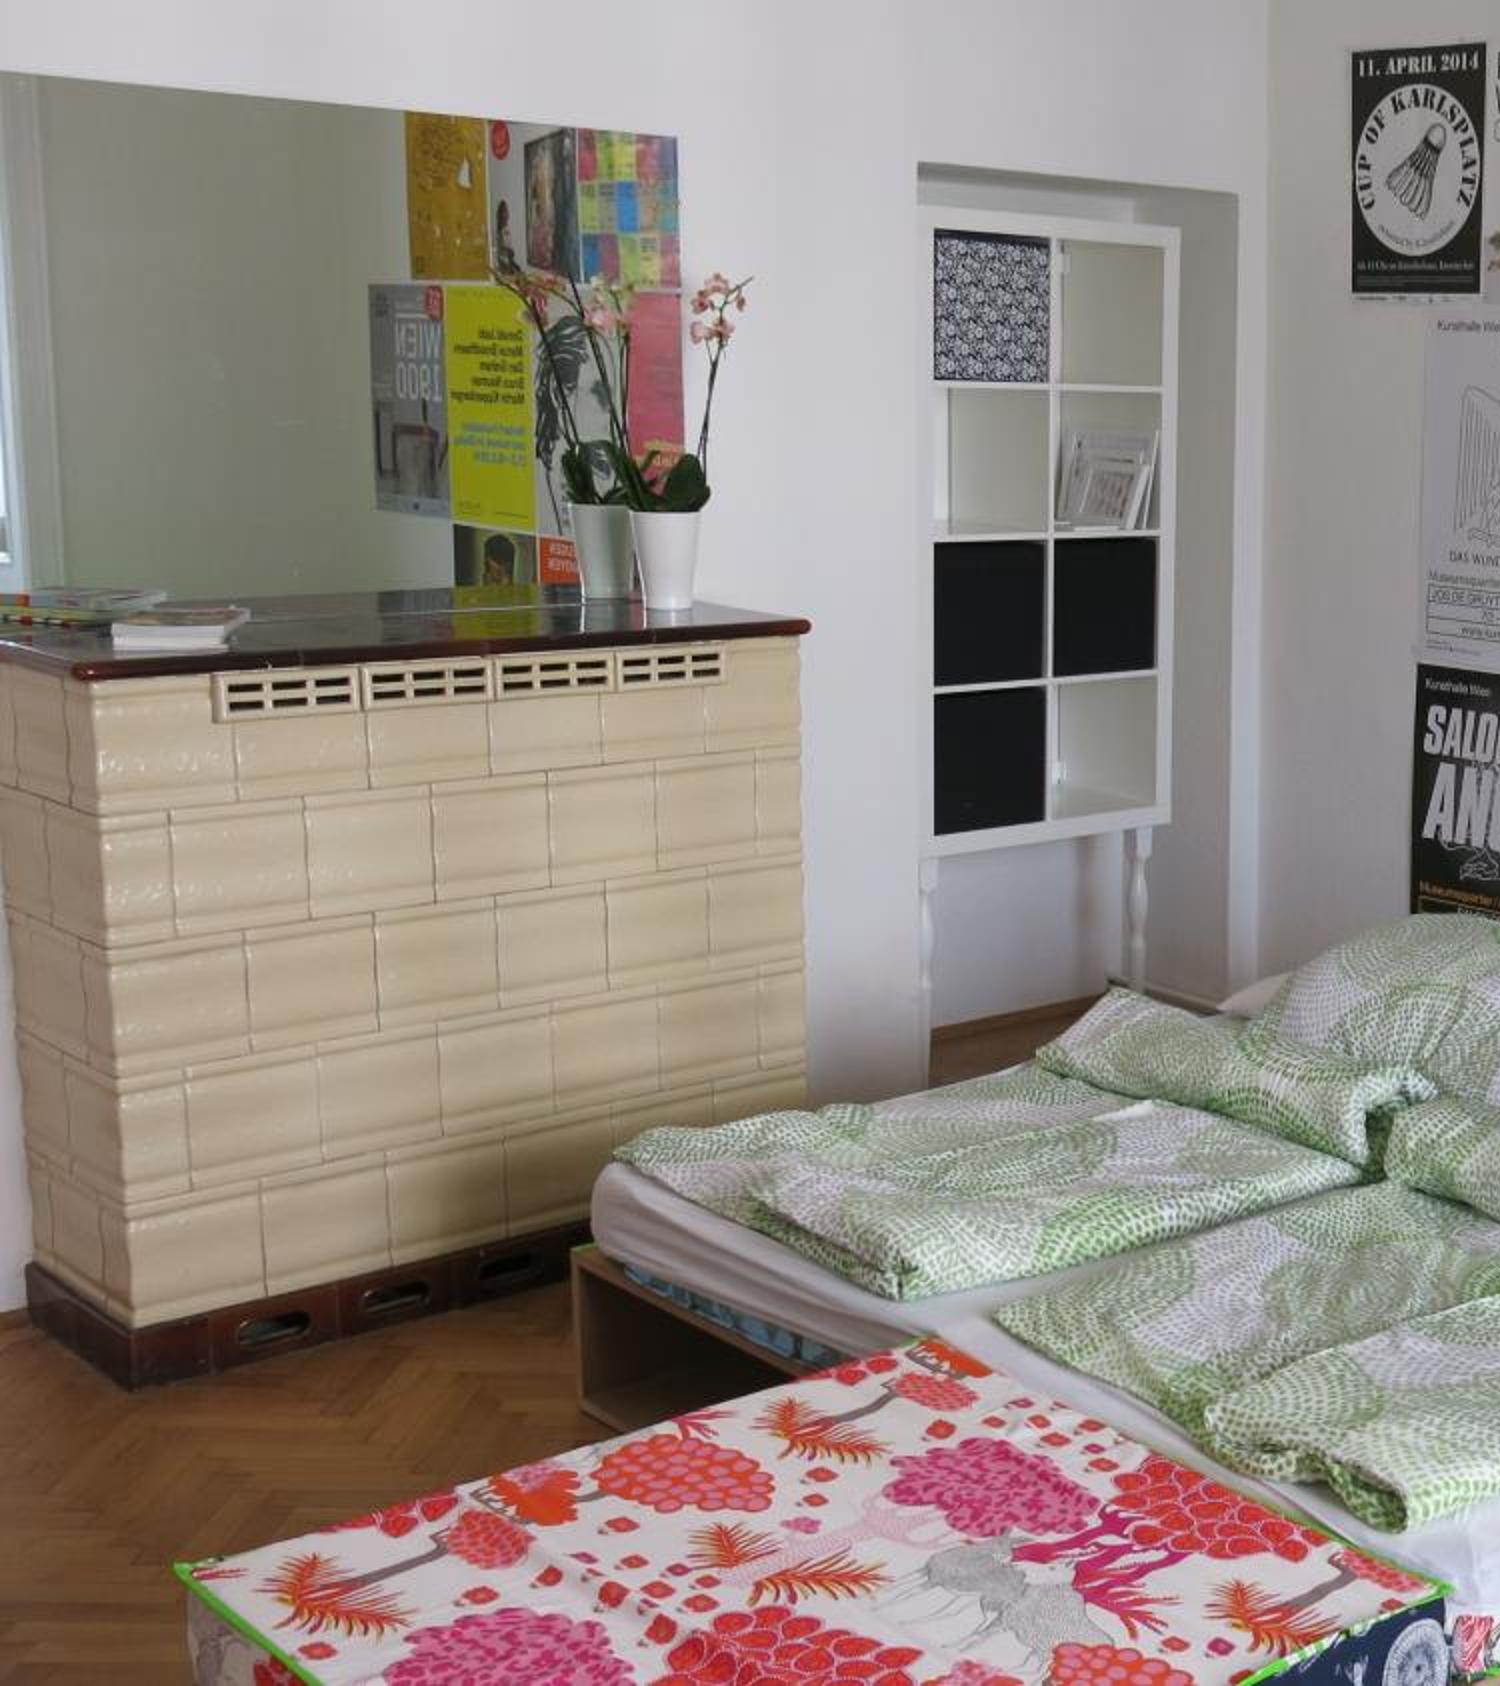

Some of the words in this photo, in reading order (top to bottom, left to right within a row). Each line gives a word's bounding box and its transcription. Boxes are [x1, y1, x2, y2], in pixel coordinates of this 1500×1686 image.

[1358, 59, 1380, 77] 11.
[1385, 55, 1437, 75] APRIL
[1441, 51, 1480, 71] 2014
[1364, 109, 1386, 145] OF
[1390, 87, 1478, 208] KARLSPLATZ
[1357, 154, 1376, 211] CUP
[1449, 551, 1469, 564] DAS
